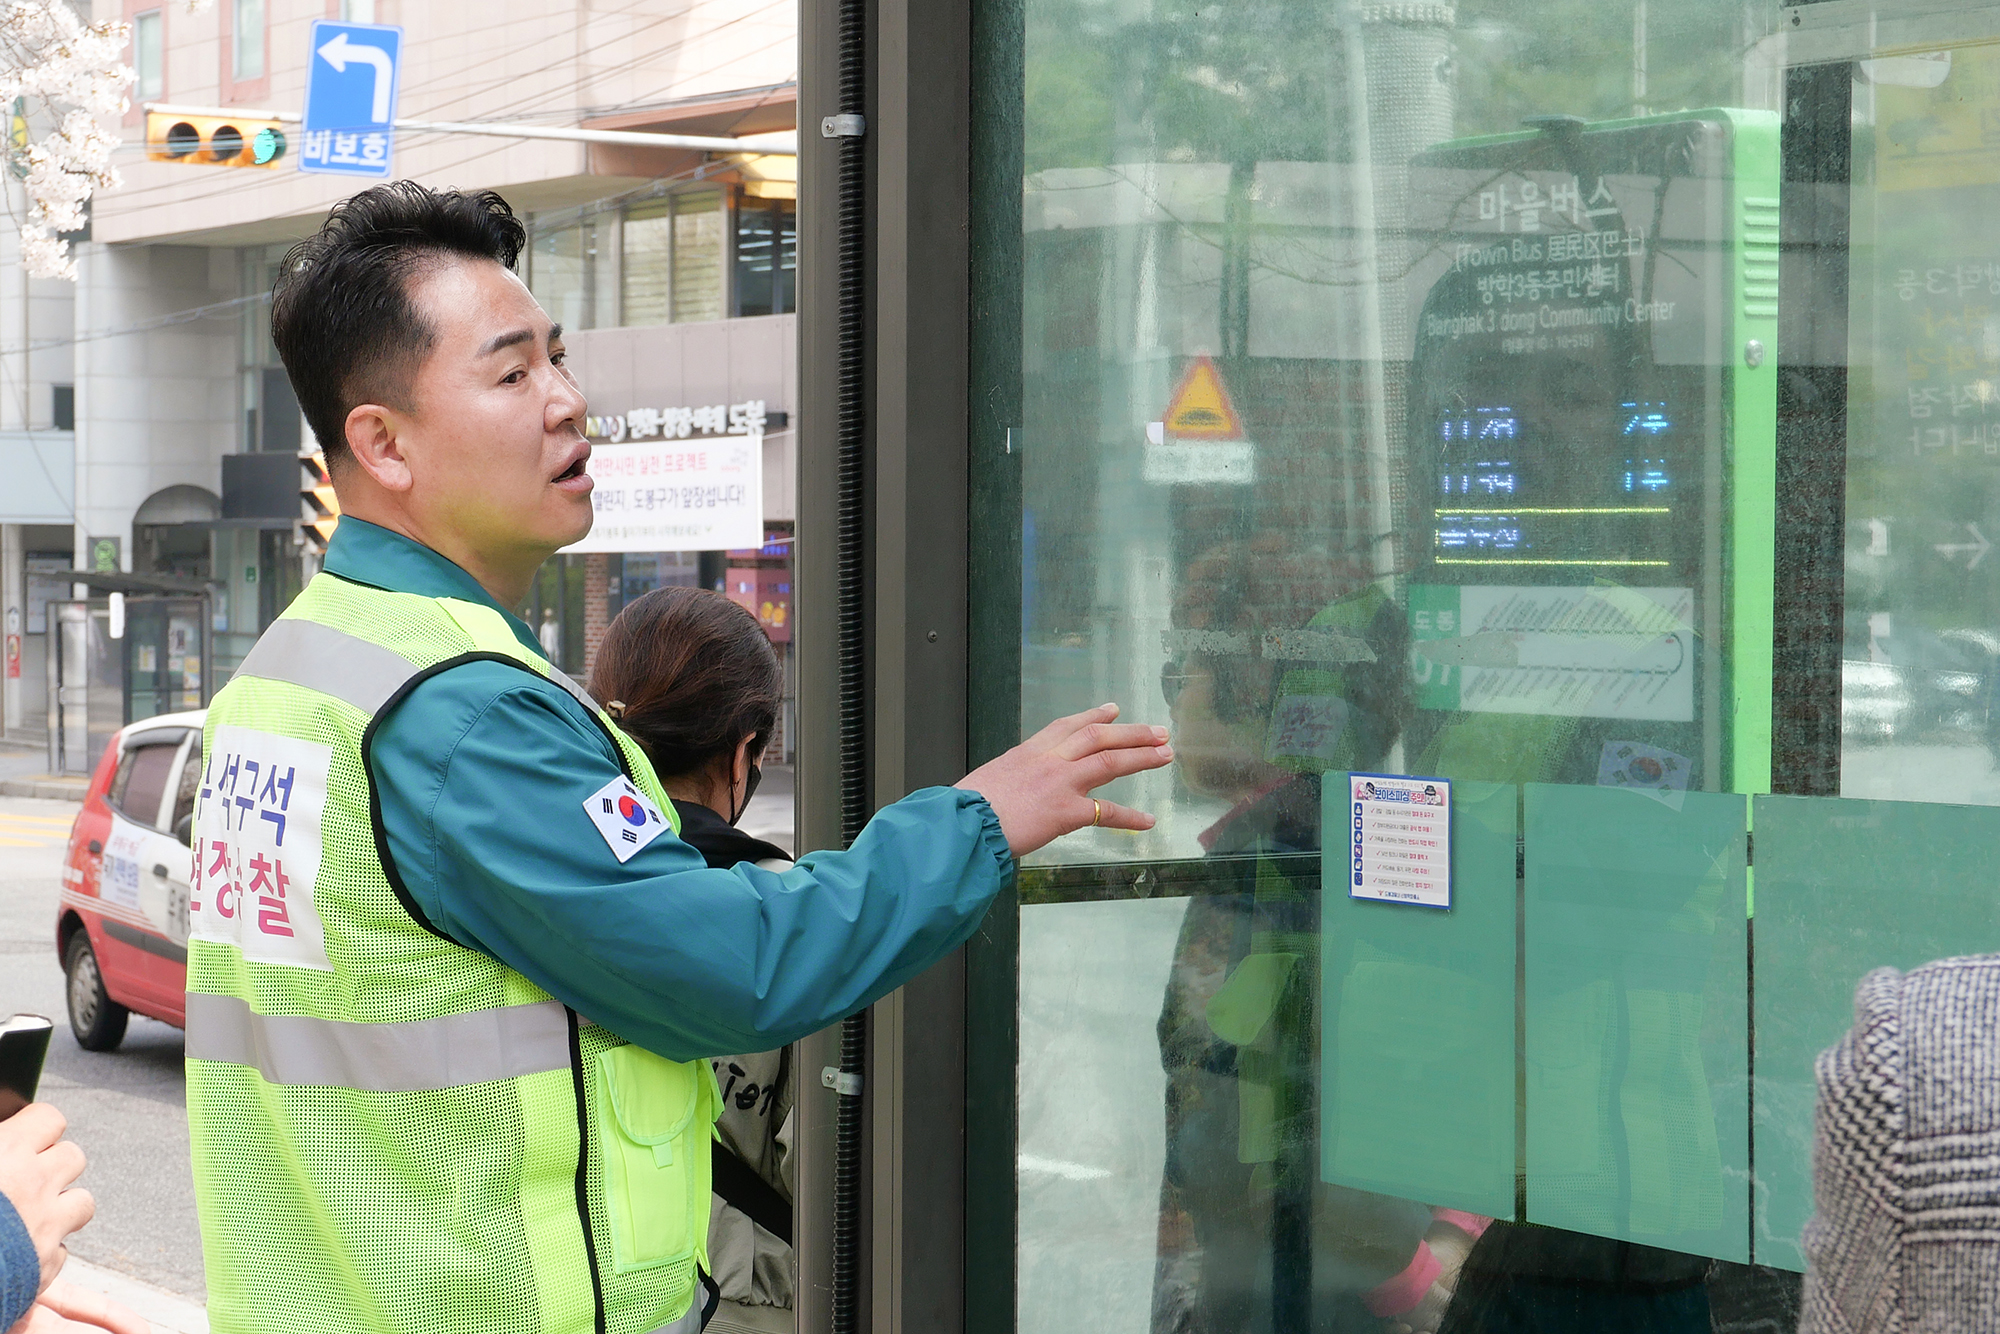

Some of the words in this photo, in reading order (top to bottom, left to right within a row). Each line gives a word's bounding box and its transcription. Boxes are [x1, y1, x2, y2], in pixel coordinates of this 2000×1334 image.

[304, 129, 387, 167] 비보호
[1479, 175, 1621, 232] 마을버스
[1512, 239, 1542, 261] Bus
[1477, 263, 1620, 305] 방학3동주민센터
[1539, 302, 1621, 329] Community
[1625, 298, 1676, 323] Center
[664, 452, 707, 473] 프로젝트
[633, 487, 679, 510] 도봉구가
[681, 485, 746, 509] 앞장섭니다!
